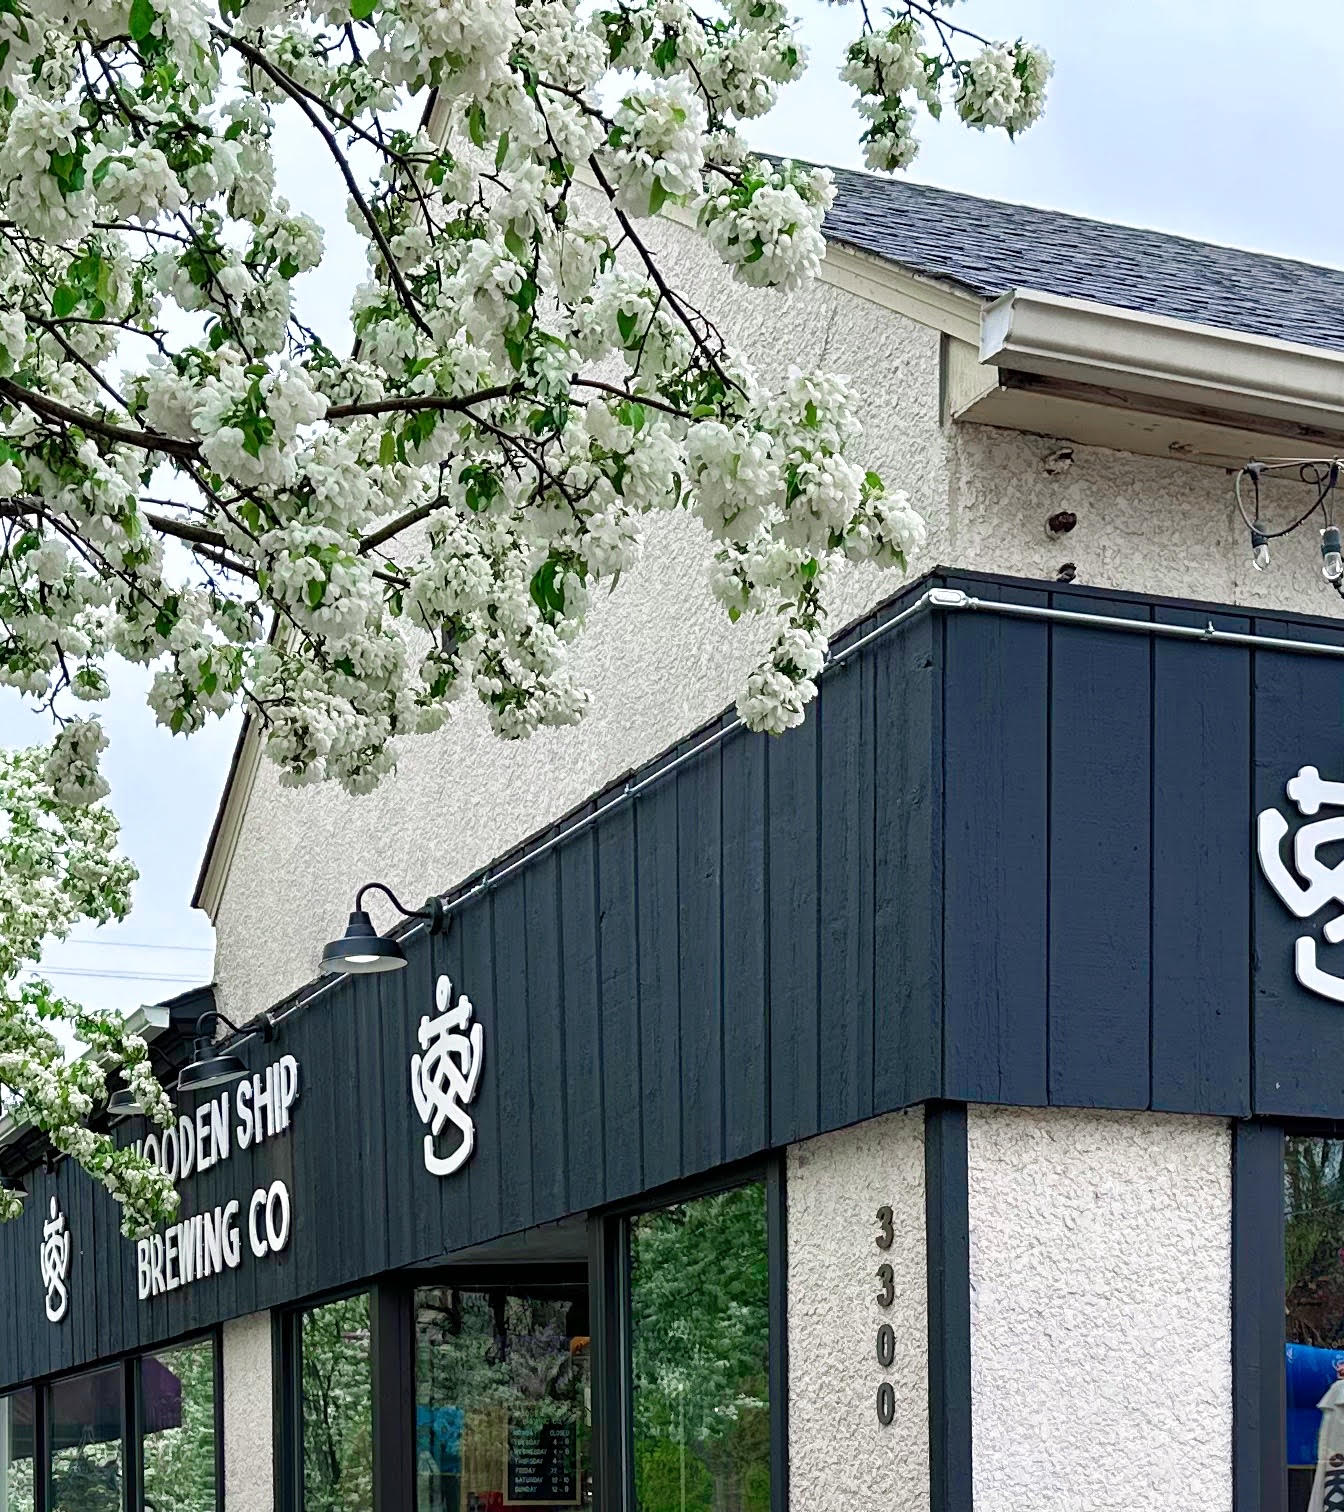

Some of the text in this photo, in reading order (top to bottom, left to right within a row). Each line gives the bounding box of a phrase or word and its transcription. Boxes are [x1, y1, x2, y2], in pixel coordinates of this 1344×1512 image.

[236, 1054, 298, 1150] SHIP
[137, 1180, 291, 1300] BREWING CO
[875, 1205, 895, 1426] 3300
